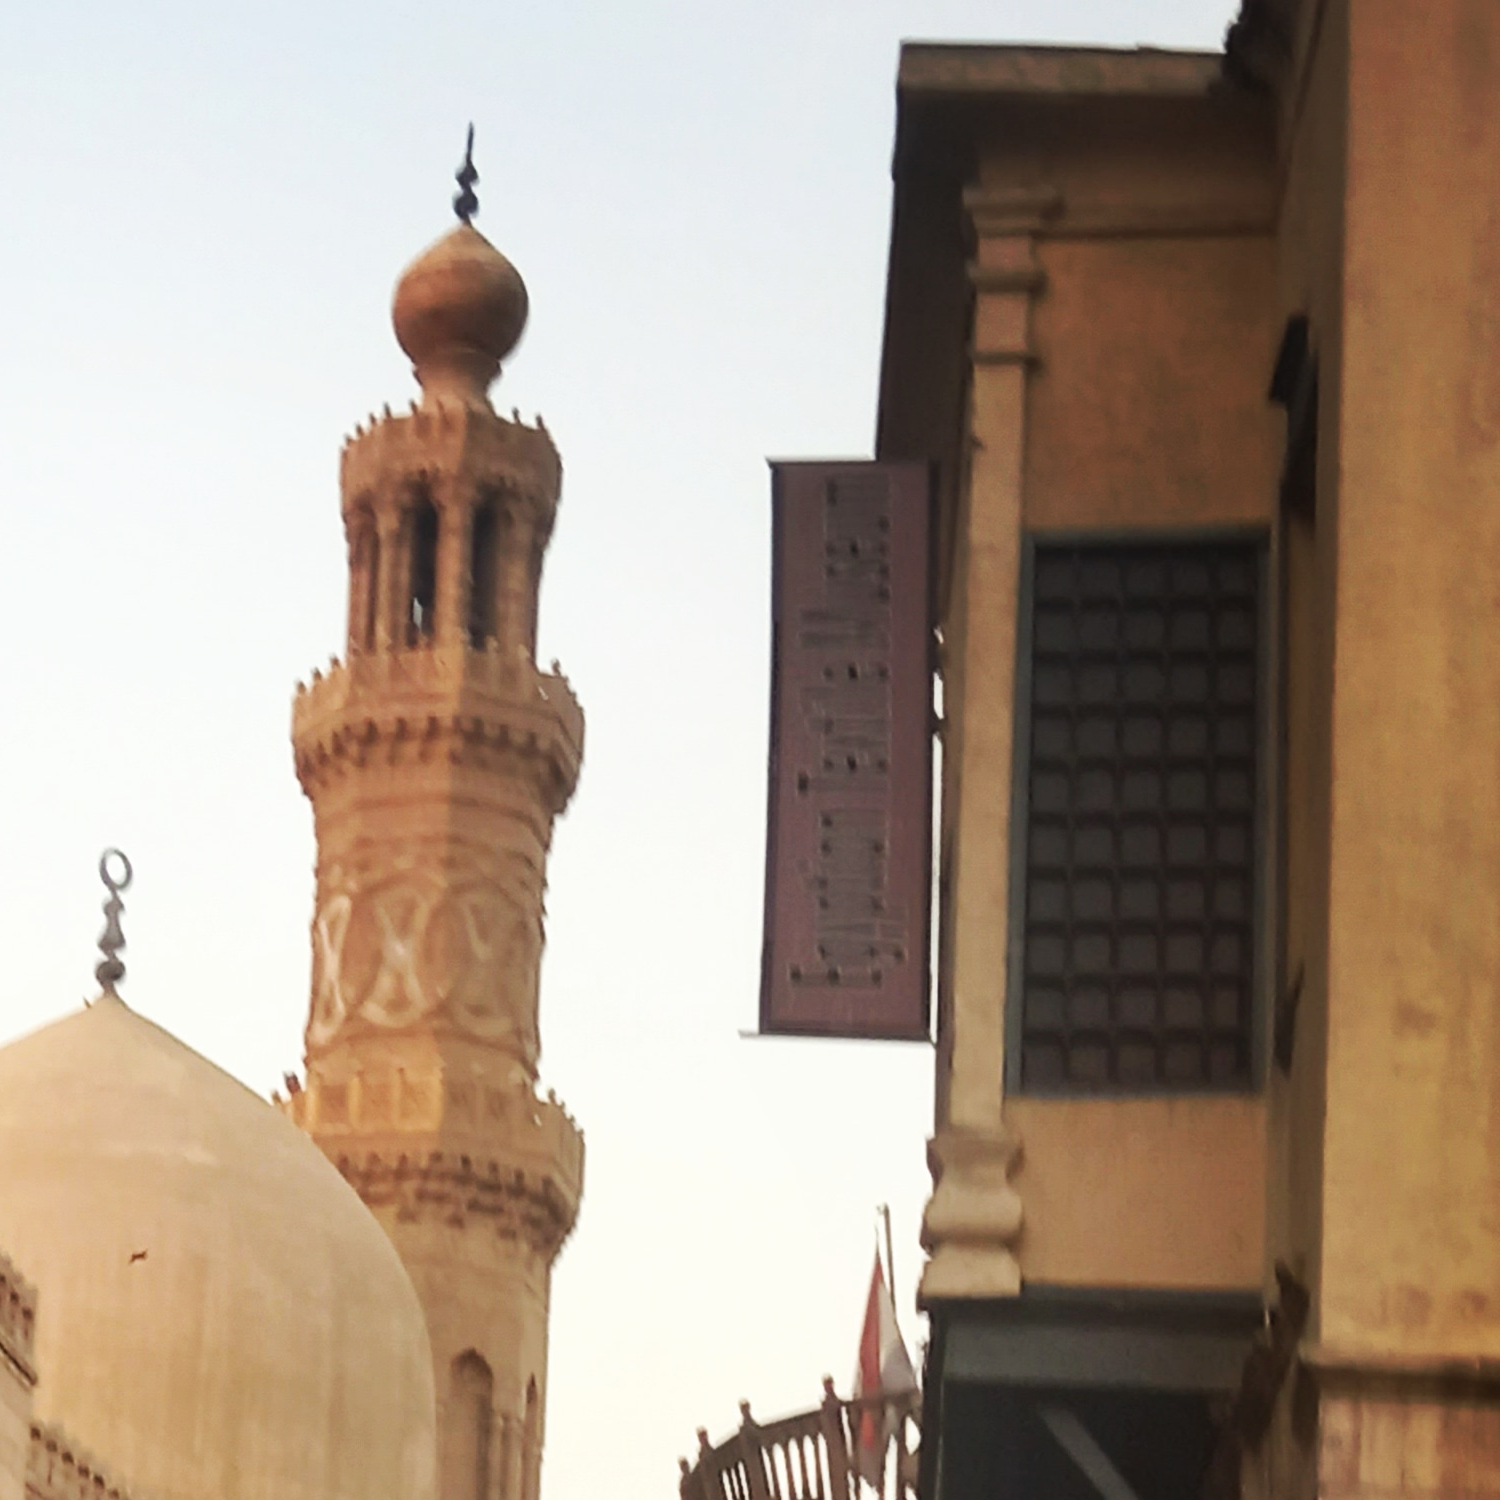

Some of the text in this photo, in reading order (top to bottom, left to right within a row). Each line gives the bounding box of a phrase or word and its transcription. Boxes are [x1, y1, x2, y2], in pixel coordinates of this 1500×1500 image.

[788, 475, 907, 990] Egyptian Textile Museum
